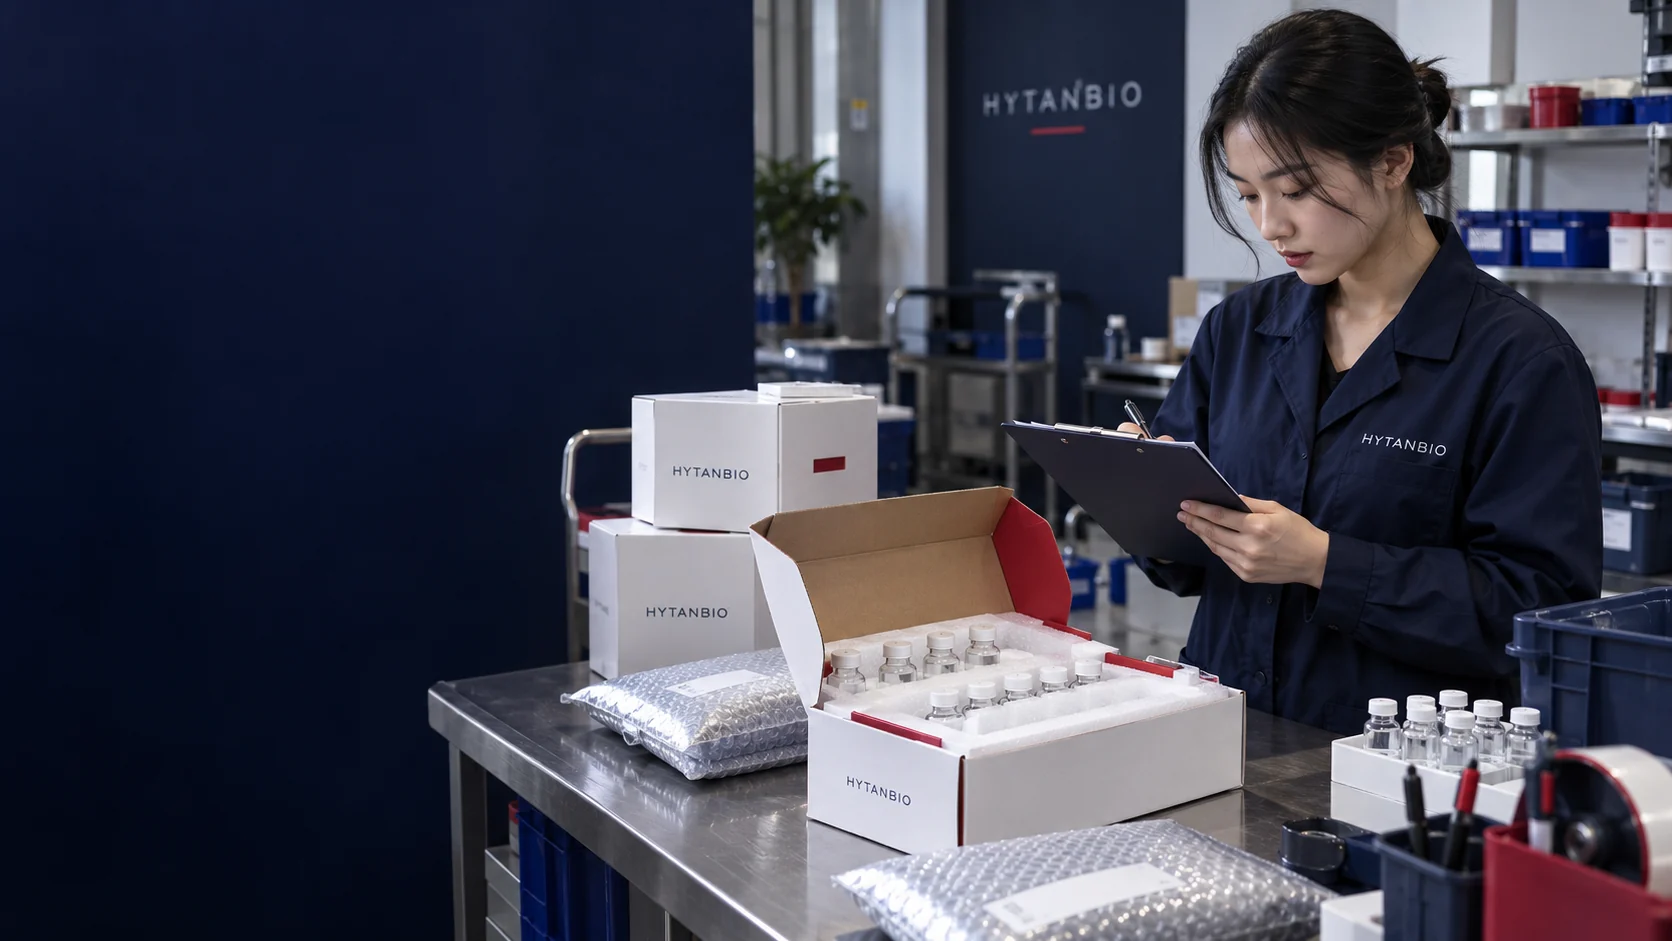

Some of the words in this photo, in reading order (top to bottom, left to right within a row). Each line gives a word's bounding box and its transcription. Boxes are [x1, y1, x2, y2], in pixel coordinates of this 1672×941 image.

[1361, 433, 1447, 457] HYTANBIO
[672, 465, 749, 481] HYTANBIO
[646, 606, 728, 619] HYTANBIO
[846, 776, 912, 806] HYTANBIO
